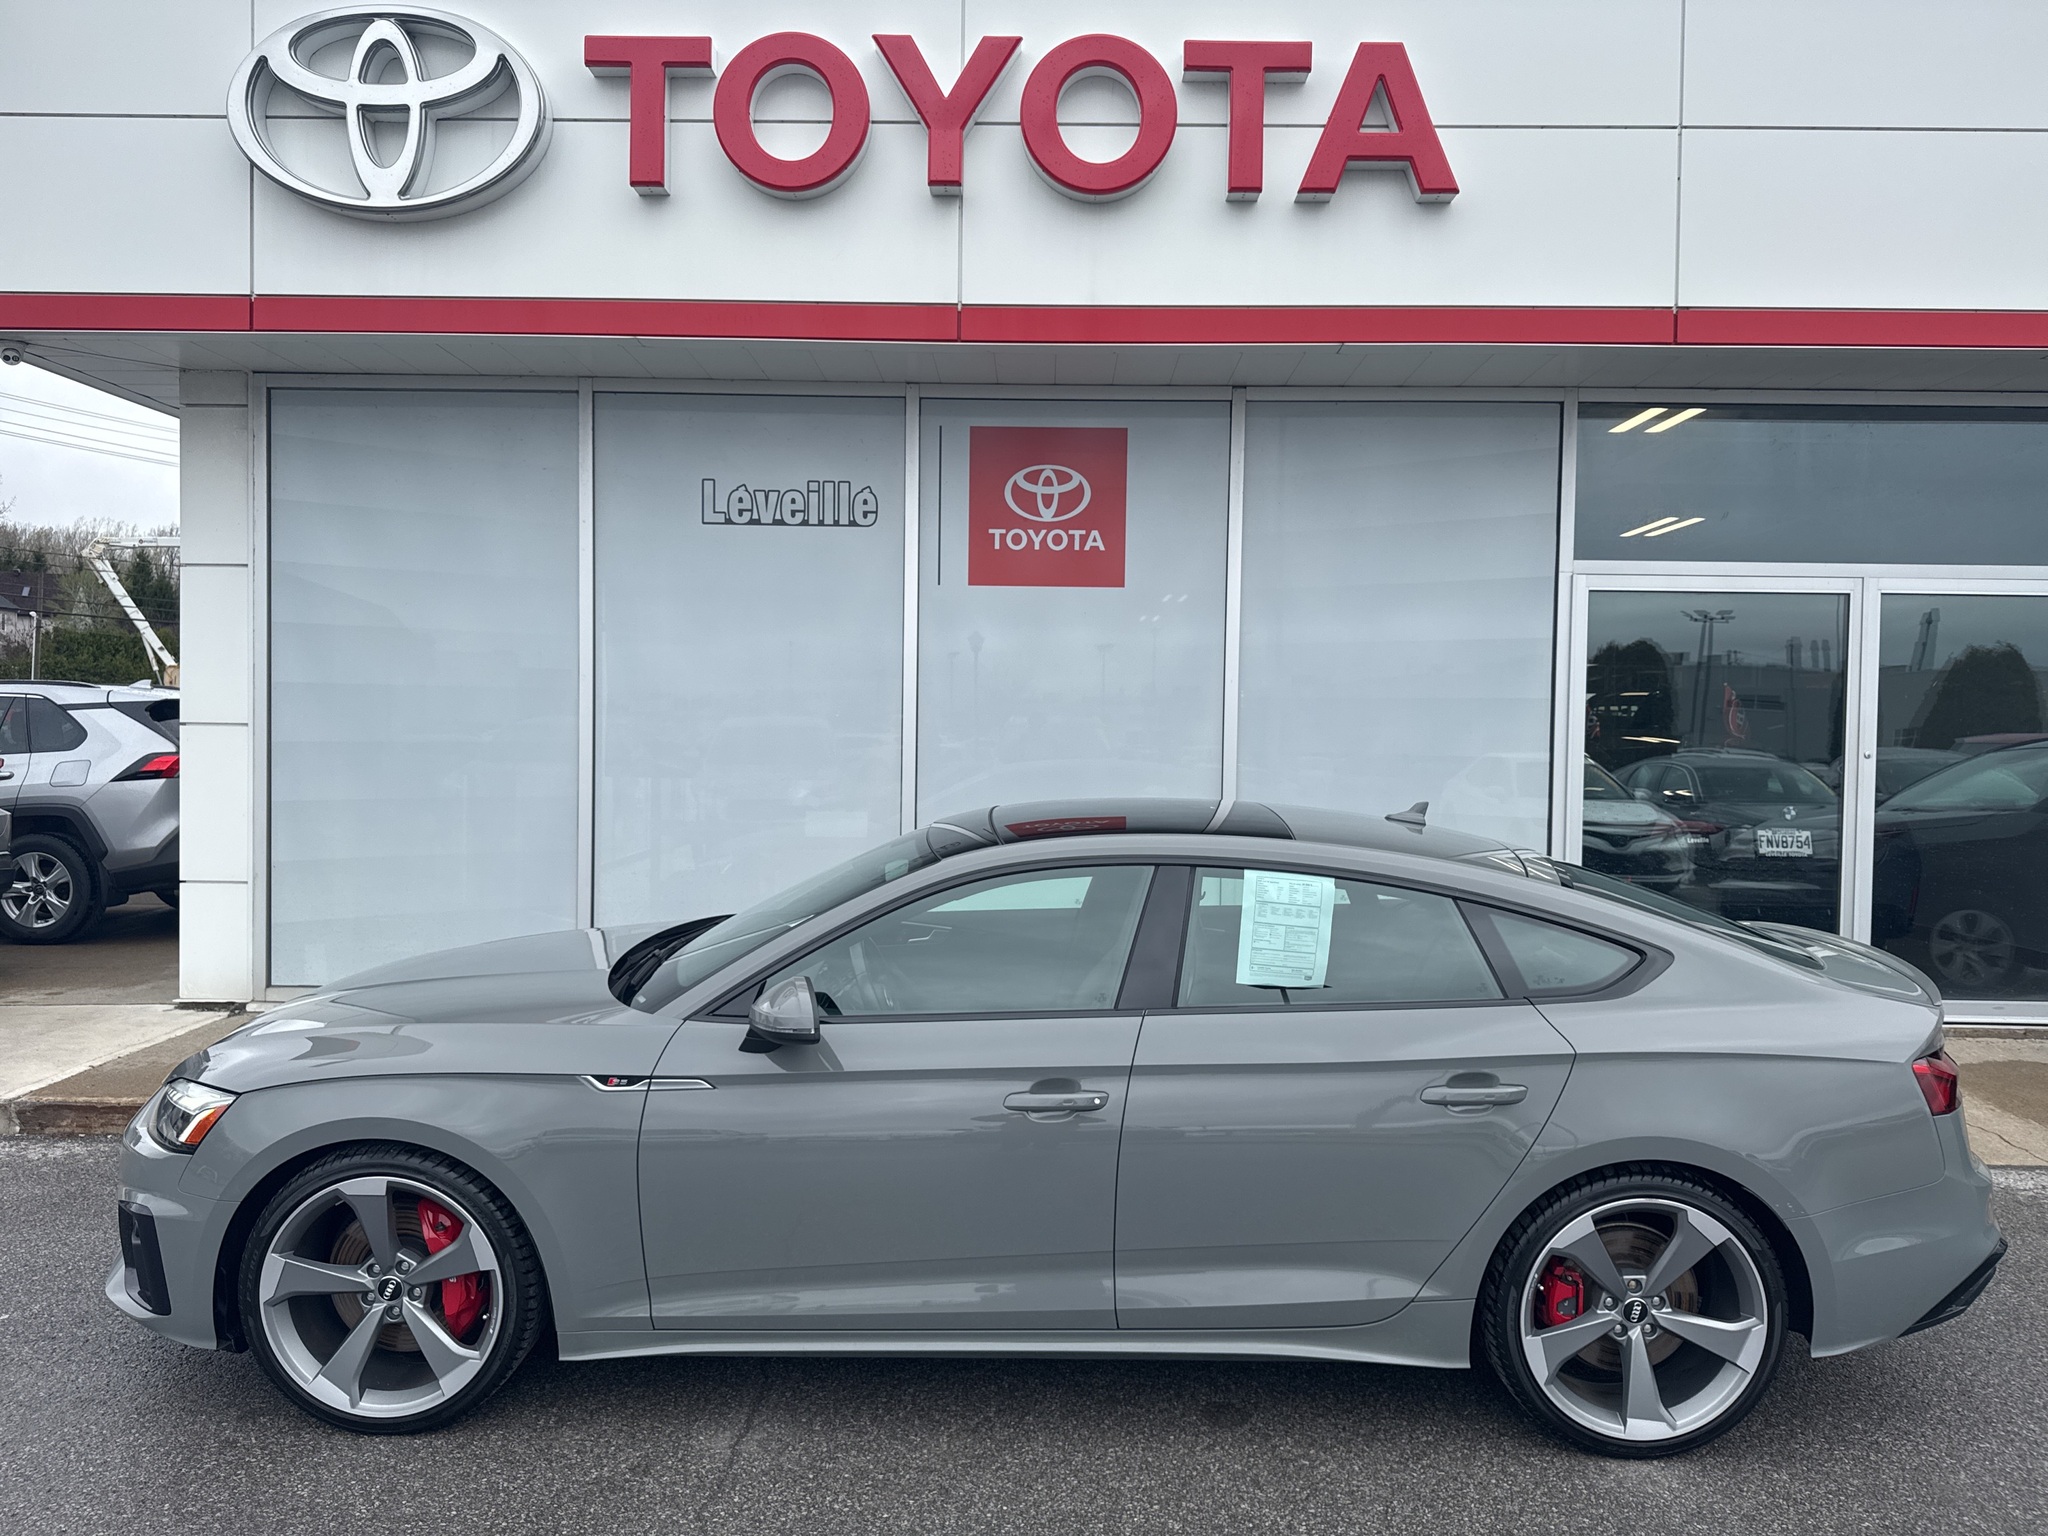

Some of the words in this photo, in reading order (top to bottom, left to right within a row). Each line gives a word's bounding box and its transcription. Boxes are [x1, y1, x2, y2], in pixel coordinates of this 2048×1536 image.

[584, 32, 1458, 201] TOYOTA
[702, 478, 878, 527] Léveillé
[988, 528, 1106, 551] TOYOTA
[1759, 835, 1811, 850] FNV8754
